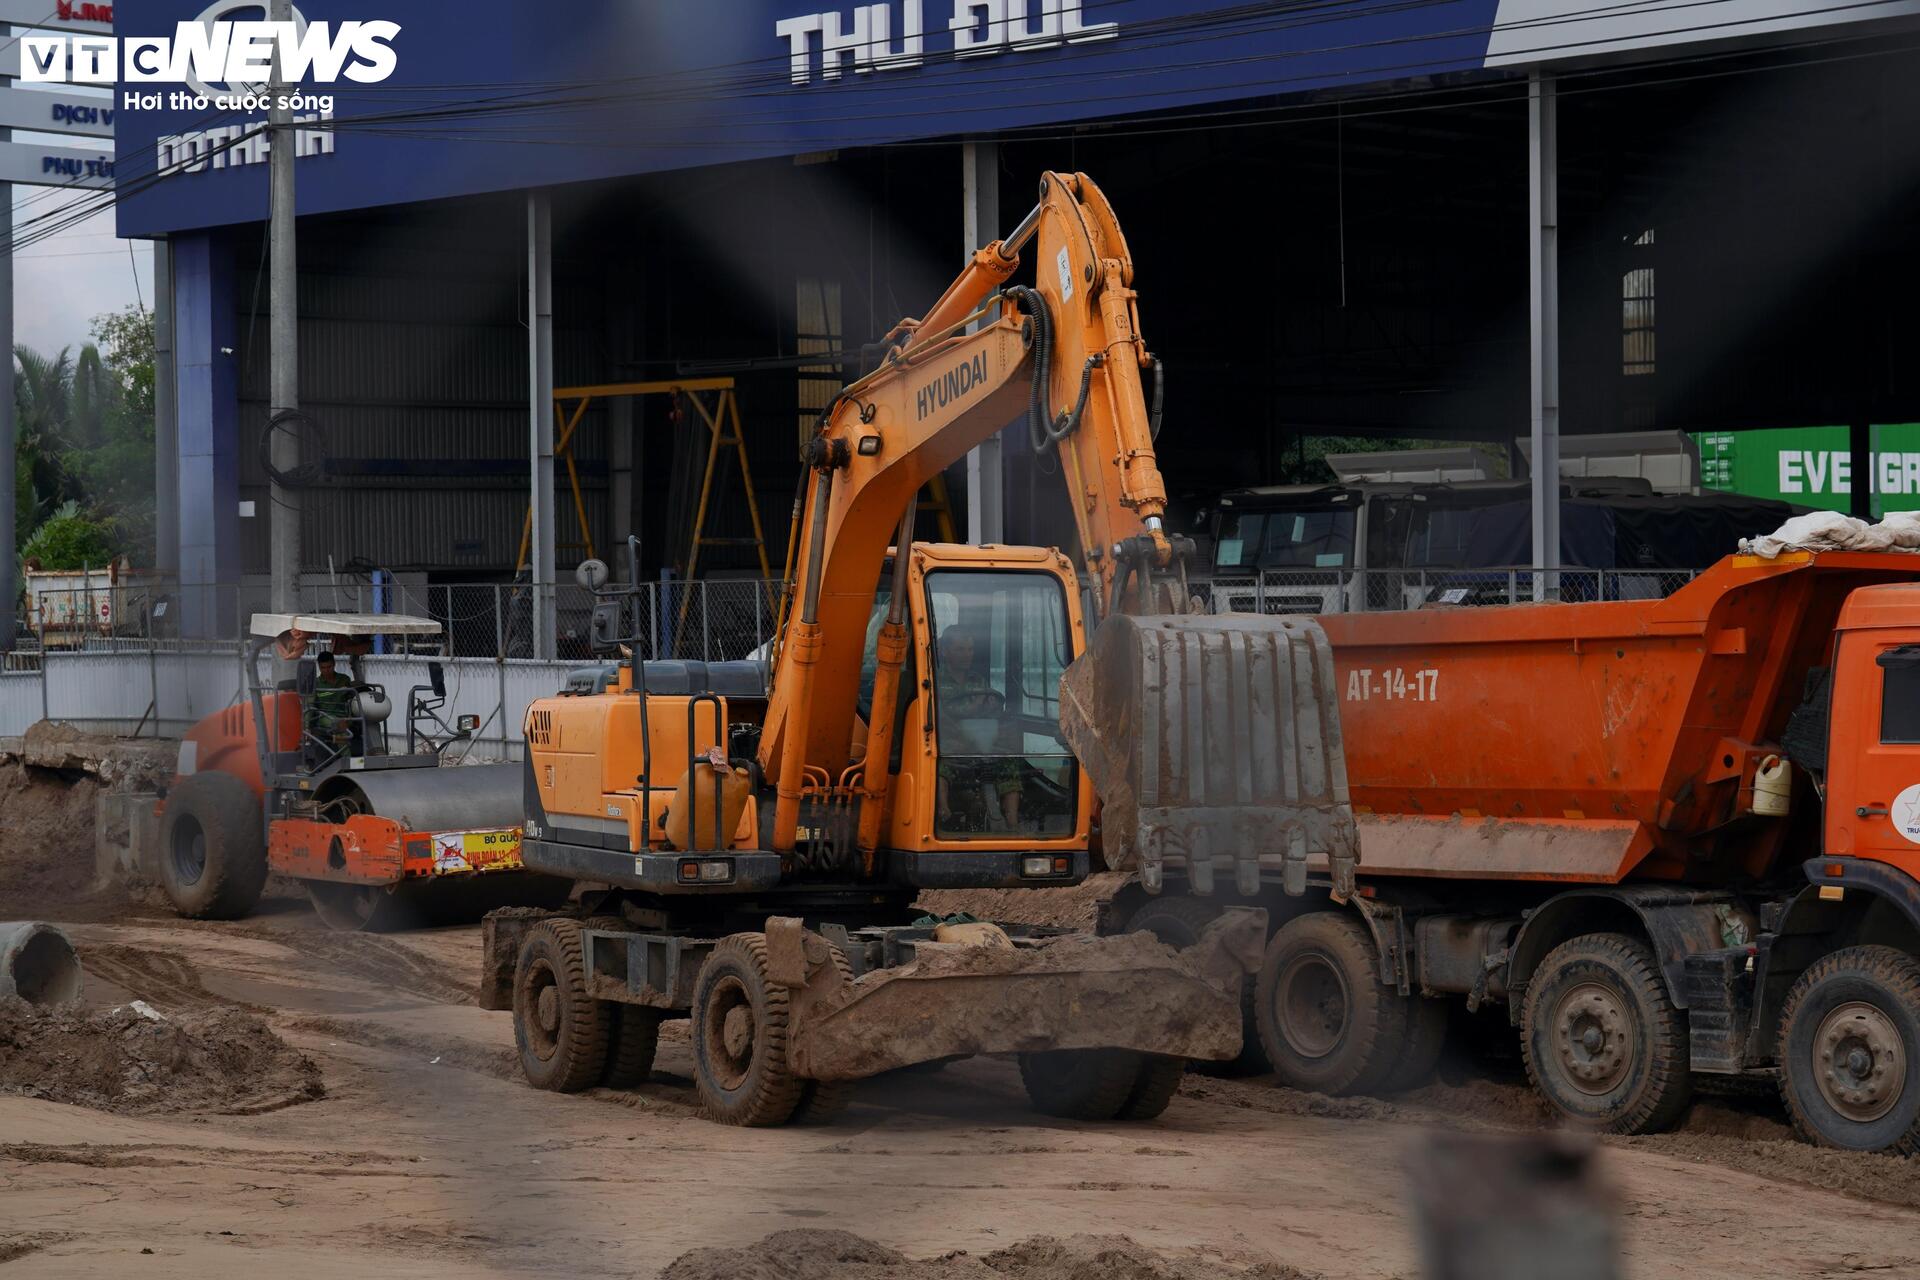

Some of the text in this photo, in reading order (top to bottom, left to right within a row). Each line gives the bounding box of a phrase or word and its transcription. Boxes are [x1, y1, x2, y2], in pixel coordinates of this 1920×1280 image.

[917, 350, 987, 421] HYUNDAI
[1778, 450, 1920, 494] EVEGR
[1347, 668, 1439, 701] AT-14-17
